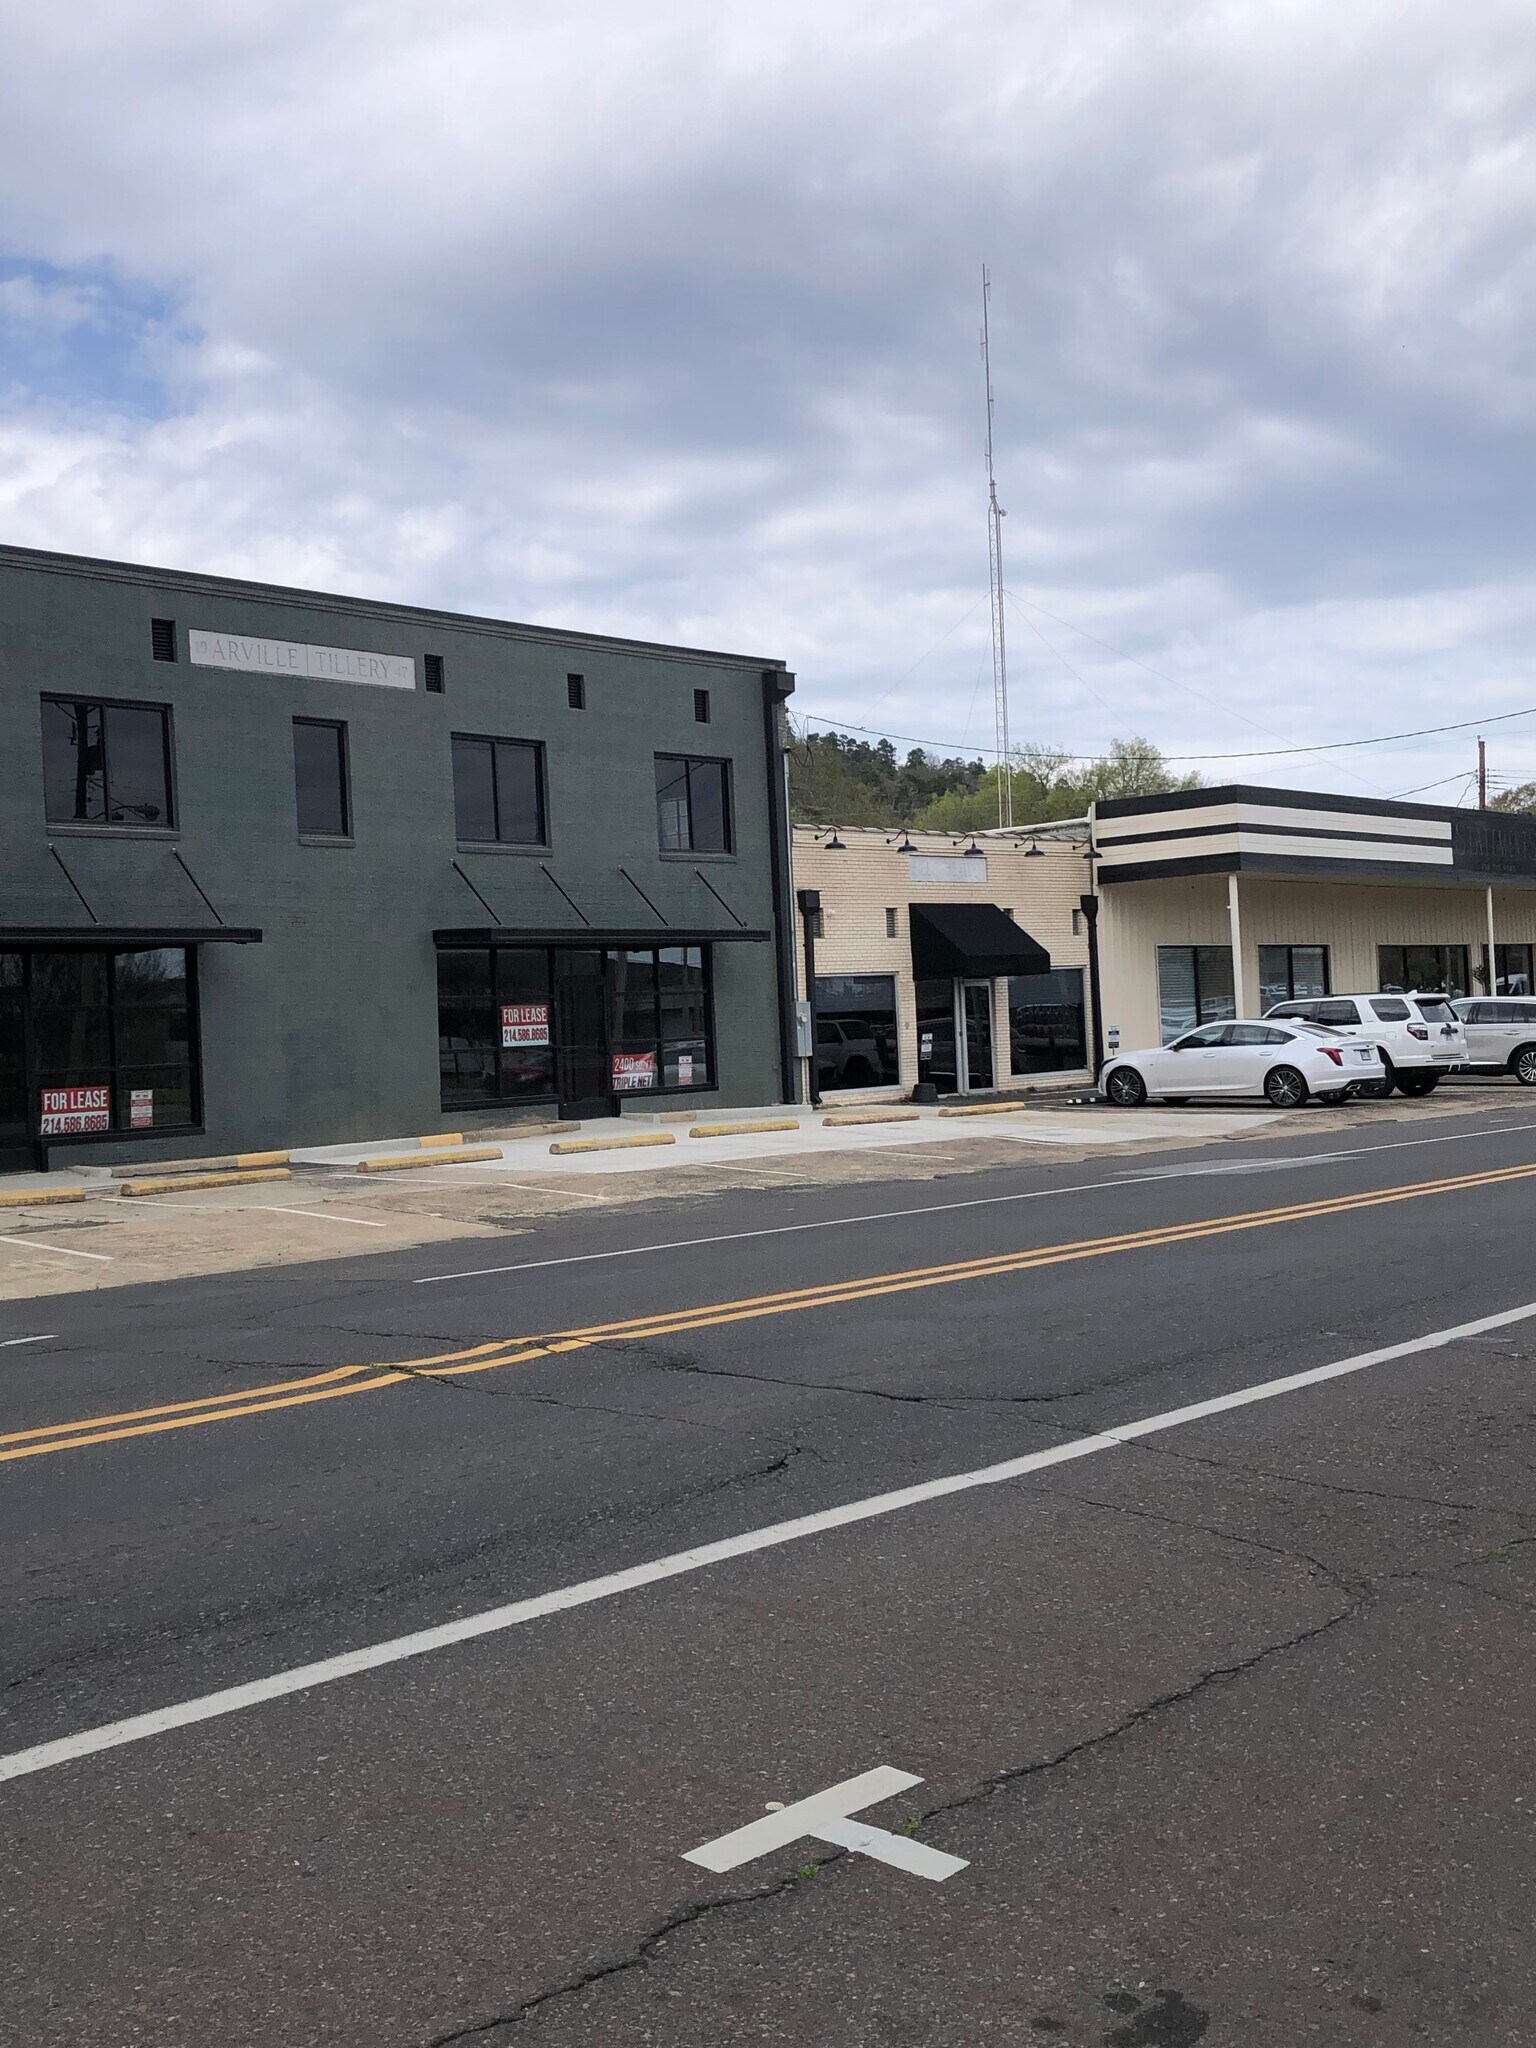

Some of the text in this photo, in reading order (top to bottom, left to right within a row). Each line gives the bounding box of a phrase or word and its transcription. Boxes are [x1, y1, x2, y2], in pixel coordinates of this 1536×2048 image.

[214, 639, 299, 669] ARVILLE
[315, 651, 392, 680] TILLERY
[503, 1007, 547, 1023] FOR LEASE
[504, 1027, 547, 1043] 214.586.8685
[614, 1057, 634, 1071] 2400
[613, 1074, 652, 1090] TRIPLE NET
[44, 1090, 108, 1110] FOR LEASE
[43, 1114, 108, 1134] 214.586.8685
